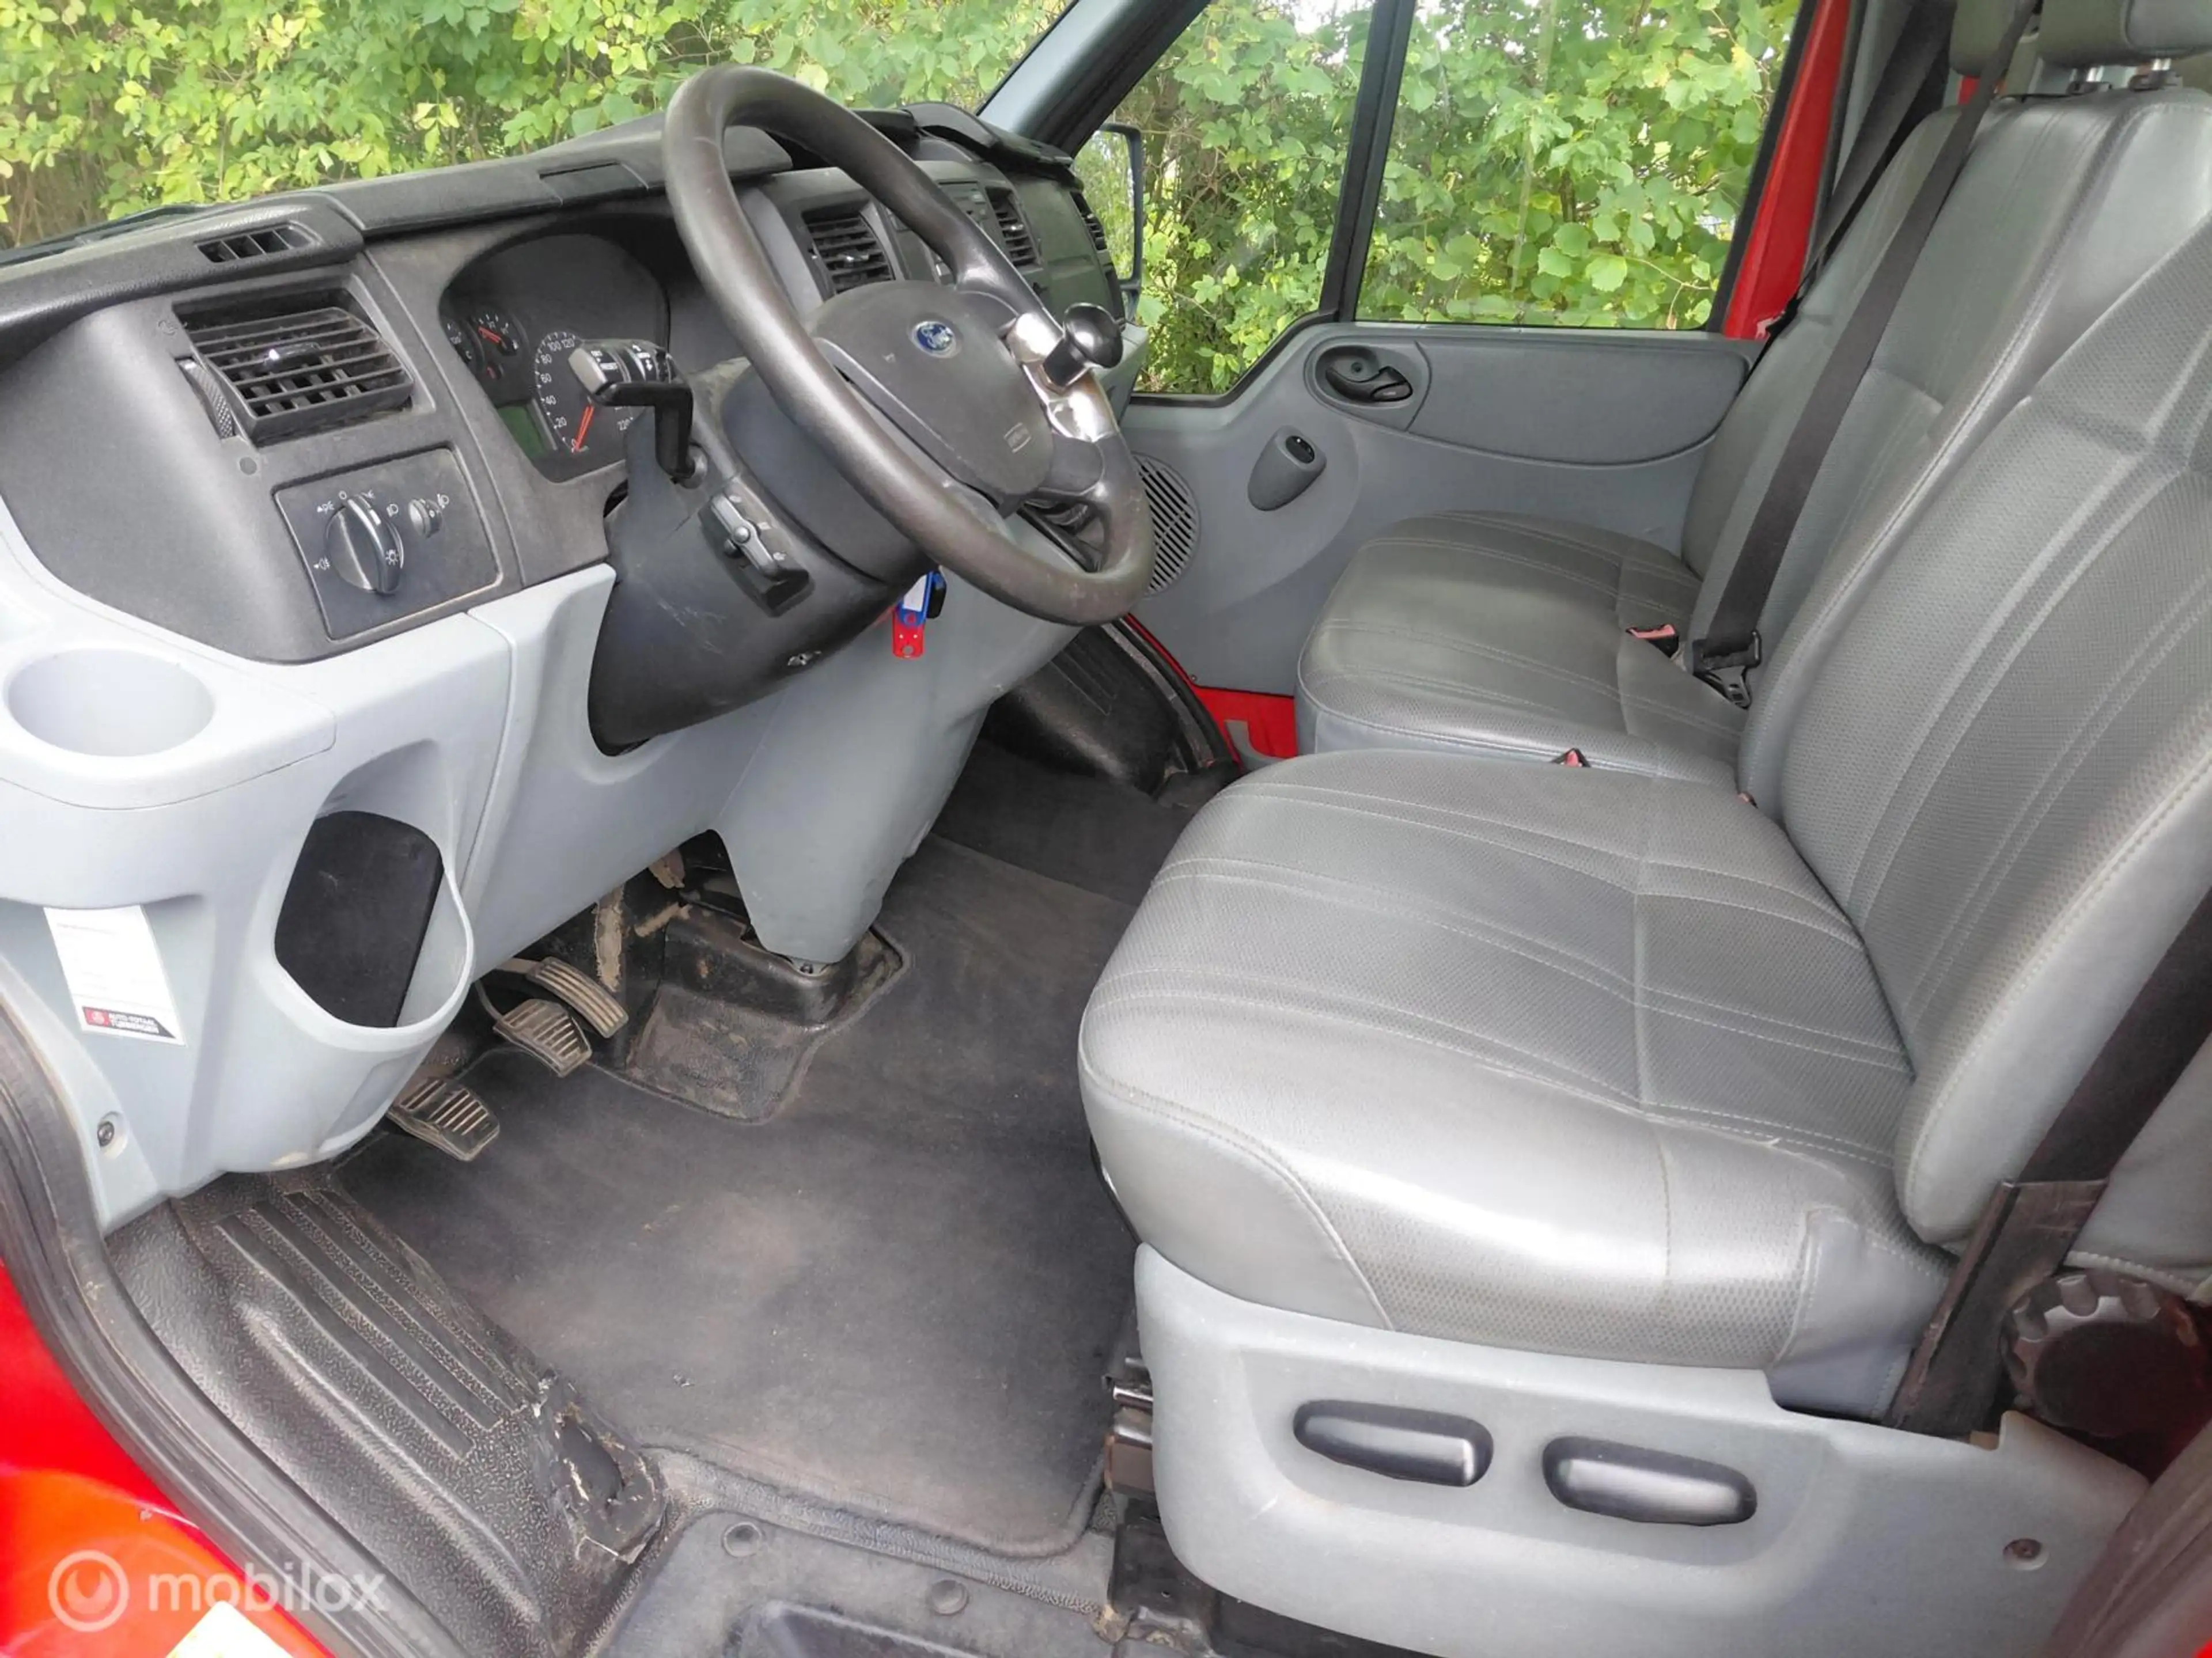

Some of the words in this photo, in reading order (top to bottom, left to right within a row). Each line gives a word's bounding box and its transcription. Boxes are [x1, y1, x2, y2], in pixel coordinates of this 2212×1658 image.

[540, 354, 552, 364] 80
[540, 373, 552, 384] 60
[546, 395, 557, 405] 40
[555, 416, 567, 428] 20
